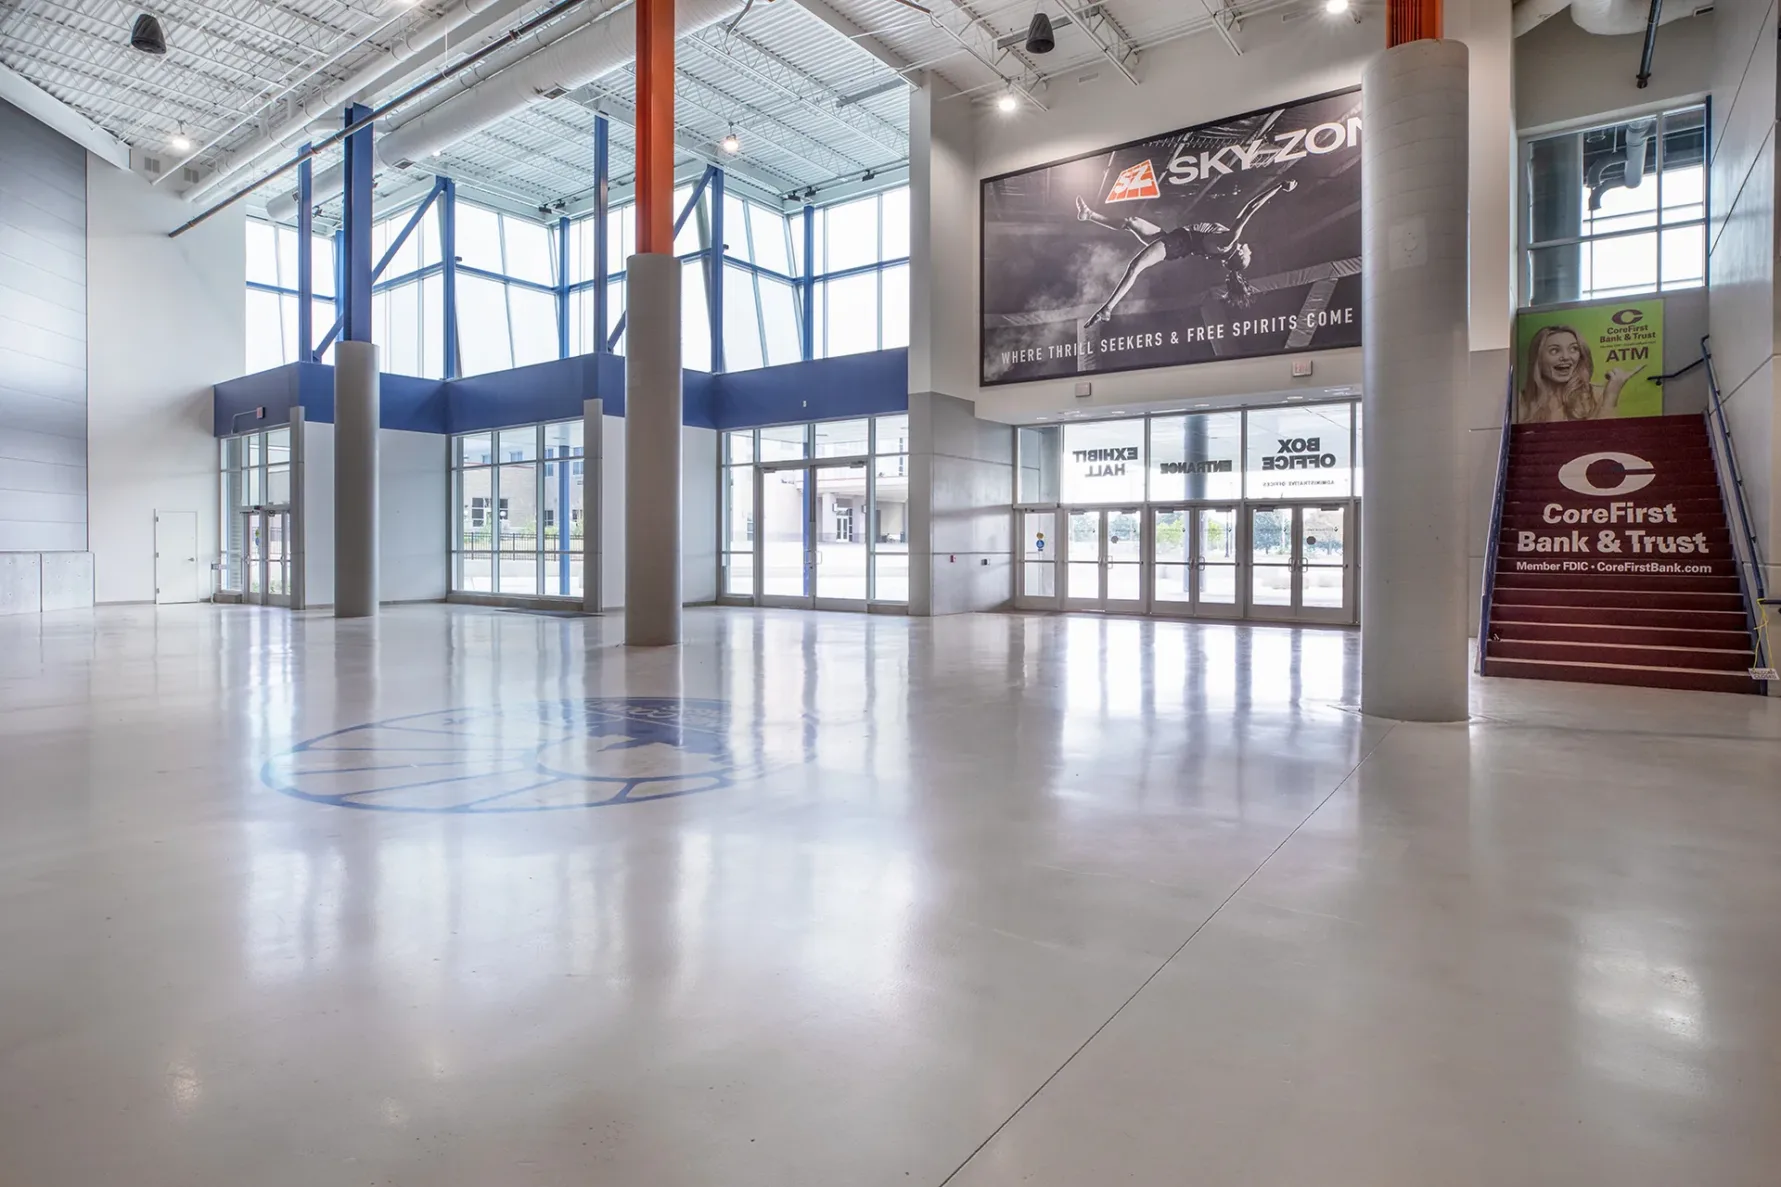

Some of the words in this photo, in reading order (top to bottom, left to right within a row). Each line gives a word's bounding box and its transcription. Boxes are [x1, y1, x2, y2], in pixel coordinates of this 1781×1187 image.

[1168, 139, 1262, 185] SKY
[1001, 347, 1042, 365] WHERE
[1049, 341, 1094, 359] THRILL
[1100, 331, 1163, 353] SEEKERS
[1170, 331, 1179, 345] &
[1187, 324, 1225, 343] FREE
[1232, 315, 1297, 337] SPIRITS
[1306, 307, 1353, 328] COME
[1600, 335, 1622, 343] Bank
[1624, 333, 1631, 341] &
[1633, 331, 1656, 340] Trust
[1607, 325, 1649, 335] CoreFirst
[1605, 346, 1649, 363] ATM
[1542, 502, 1678, 524] CoreFirst
[1517, 530, 1590, 553] Bank
[1596, 530, 1623, 553] &
[1625, 530, 1710, 554] Trust
[1516, 561, 1561, 571] Member
[1563, 561, 1589, 571] FDIC
[1597, 561, 1712, 574] CoreFirstBank.com
